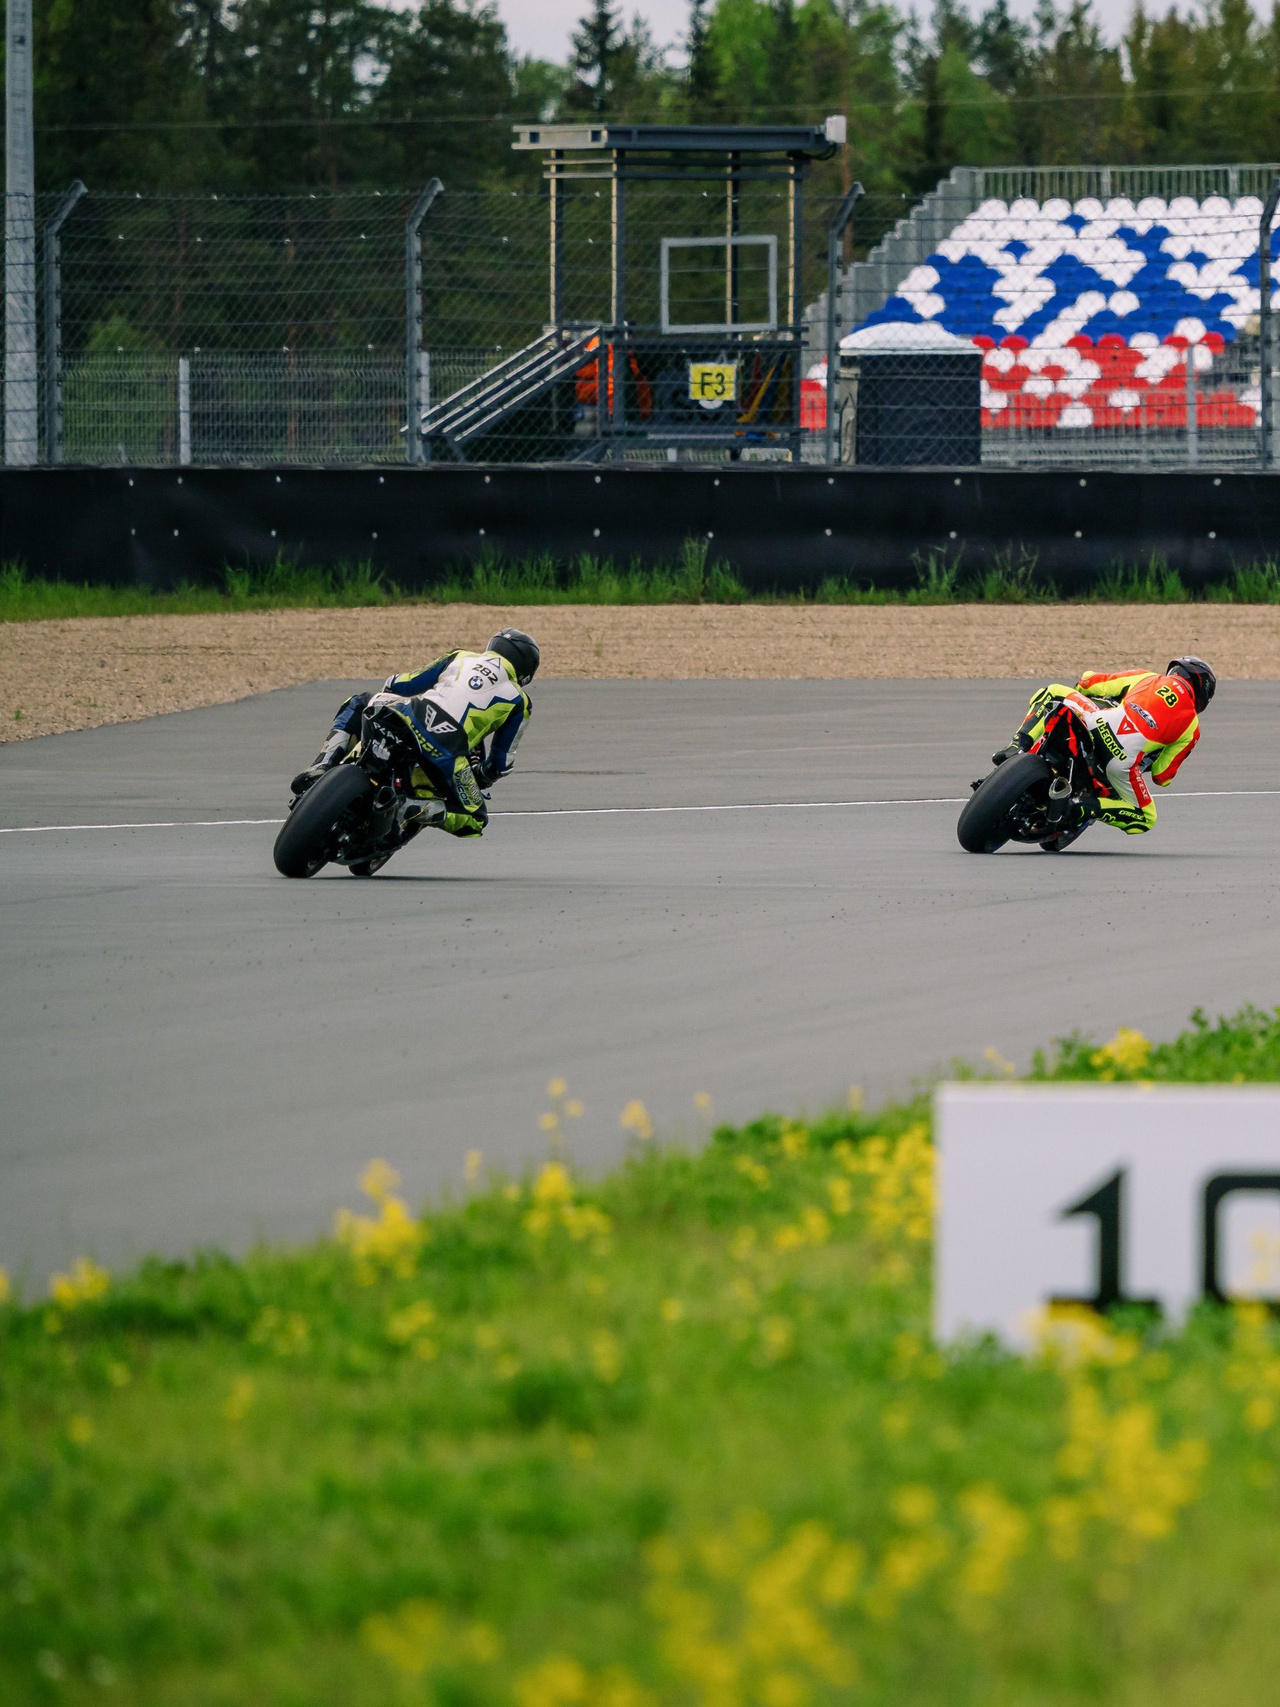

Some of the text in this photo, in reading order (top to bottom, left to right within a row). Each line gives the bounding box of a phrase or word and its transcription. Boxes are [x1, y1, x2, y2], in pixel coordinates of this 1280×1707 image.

[700, 372, 726, 396] F3
[472, 663, 499, 685] 282
[1155, 686, 1179, 708] 28
[373, 722, 402, 744] PLAY
